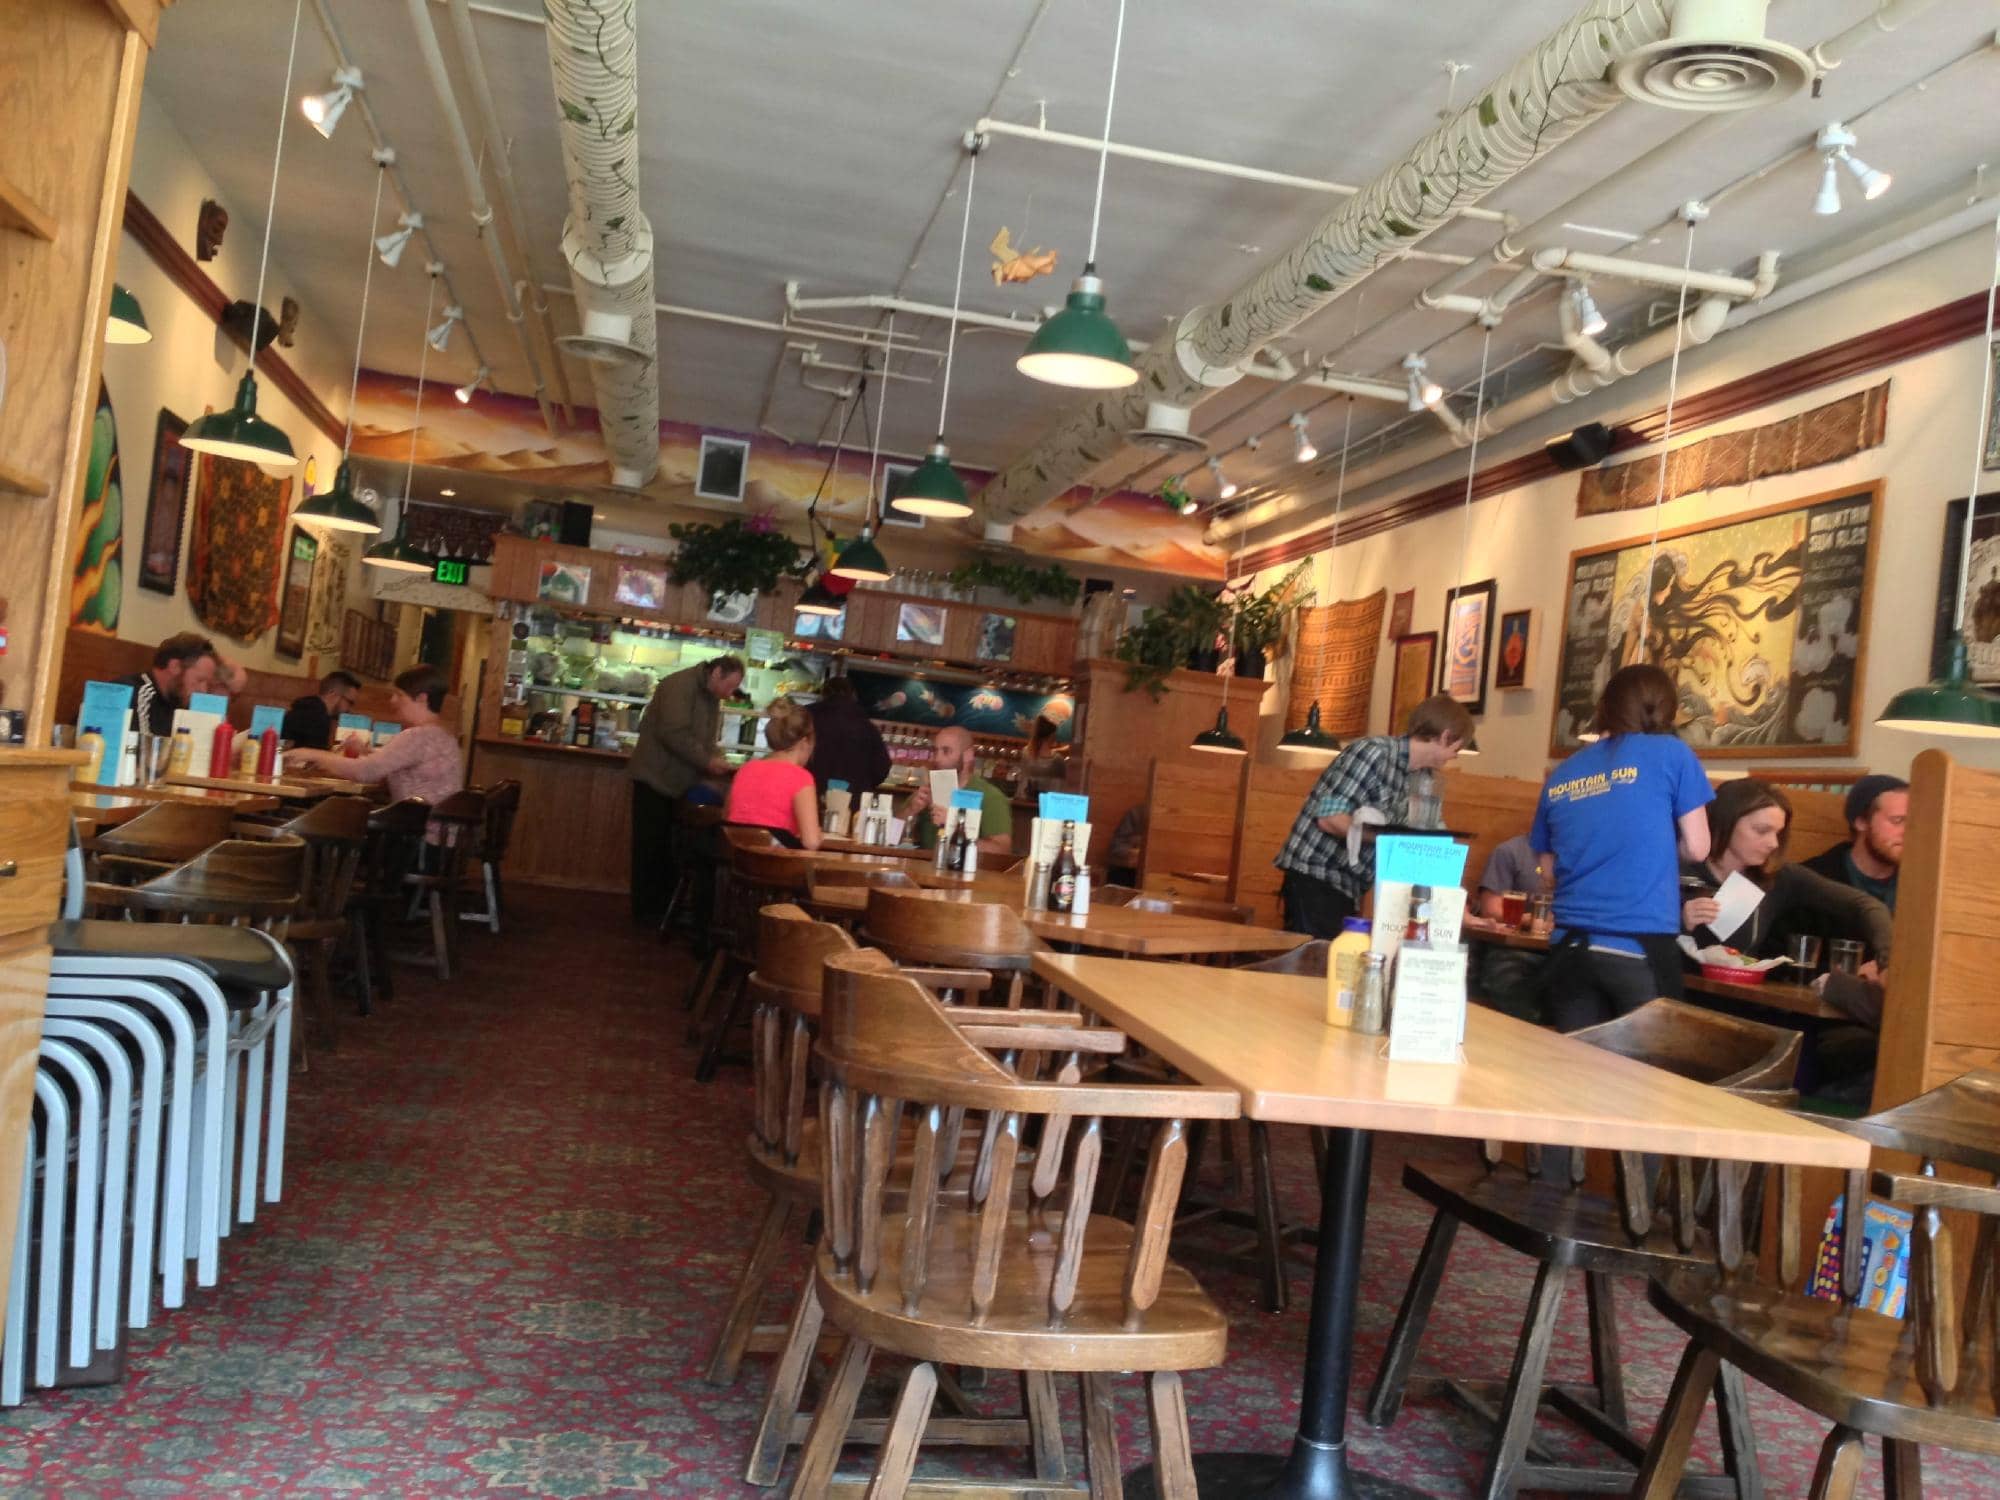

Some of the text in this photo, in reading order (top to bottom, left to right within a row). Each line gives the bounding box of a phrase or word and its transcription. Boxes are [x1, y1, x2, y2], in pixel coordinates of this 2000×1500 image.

[437, 560, 464, 583] EXIT
[1549, 773, 1606, 798] MOUNTAIN
[1611, 767, 1638, 780] SUN
[1433, 927, 1454, 939] SUN
